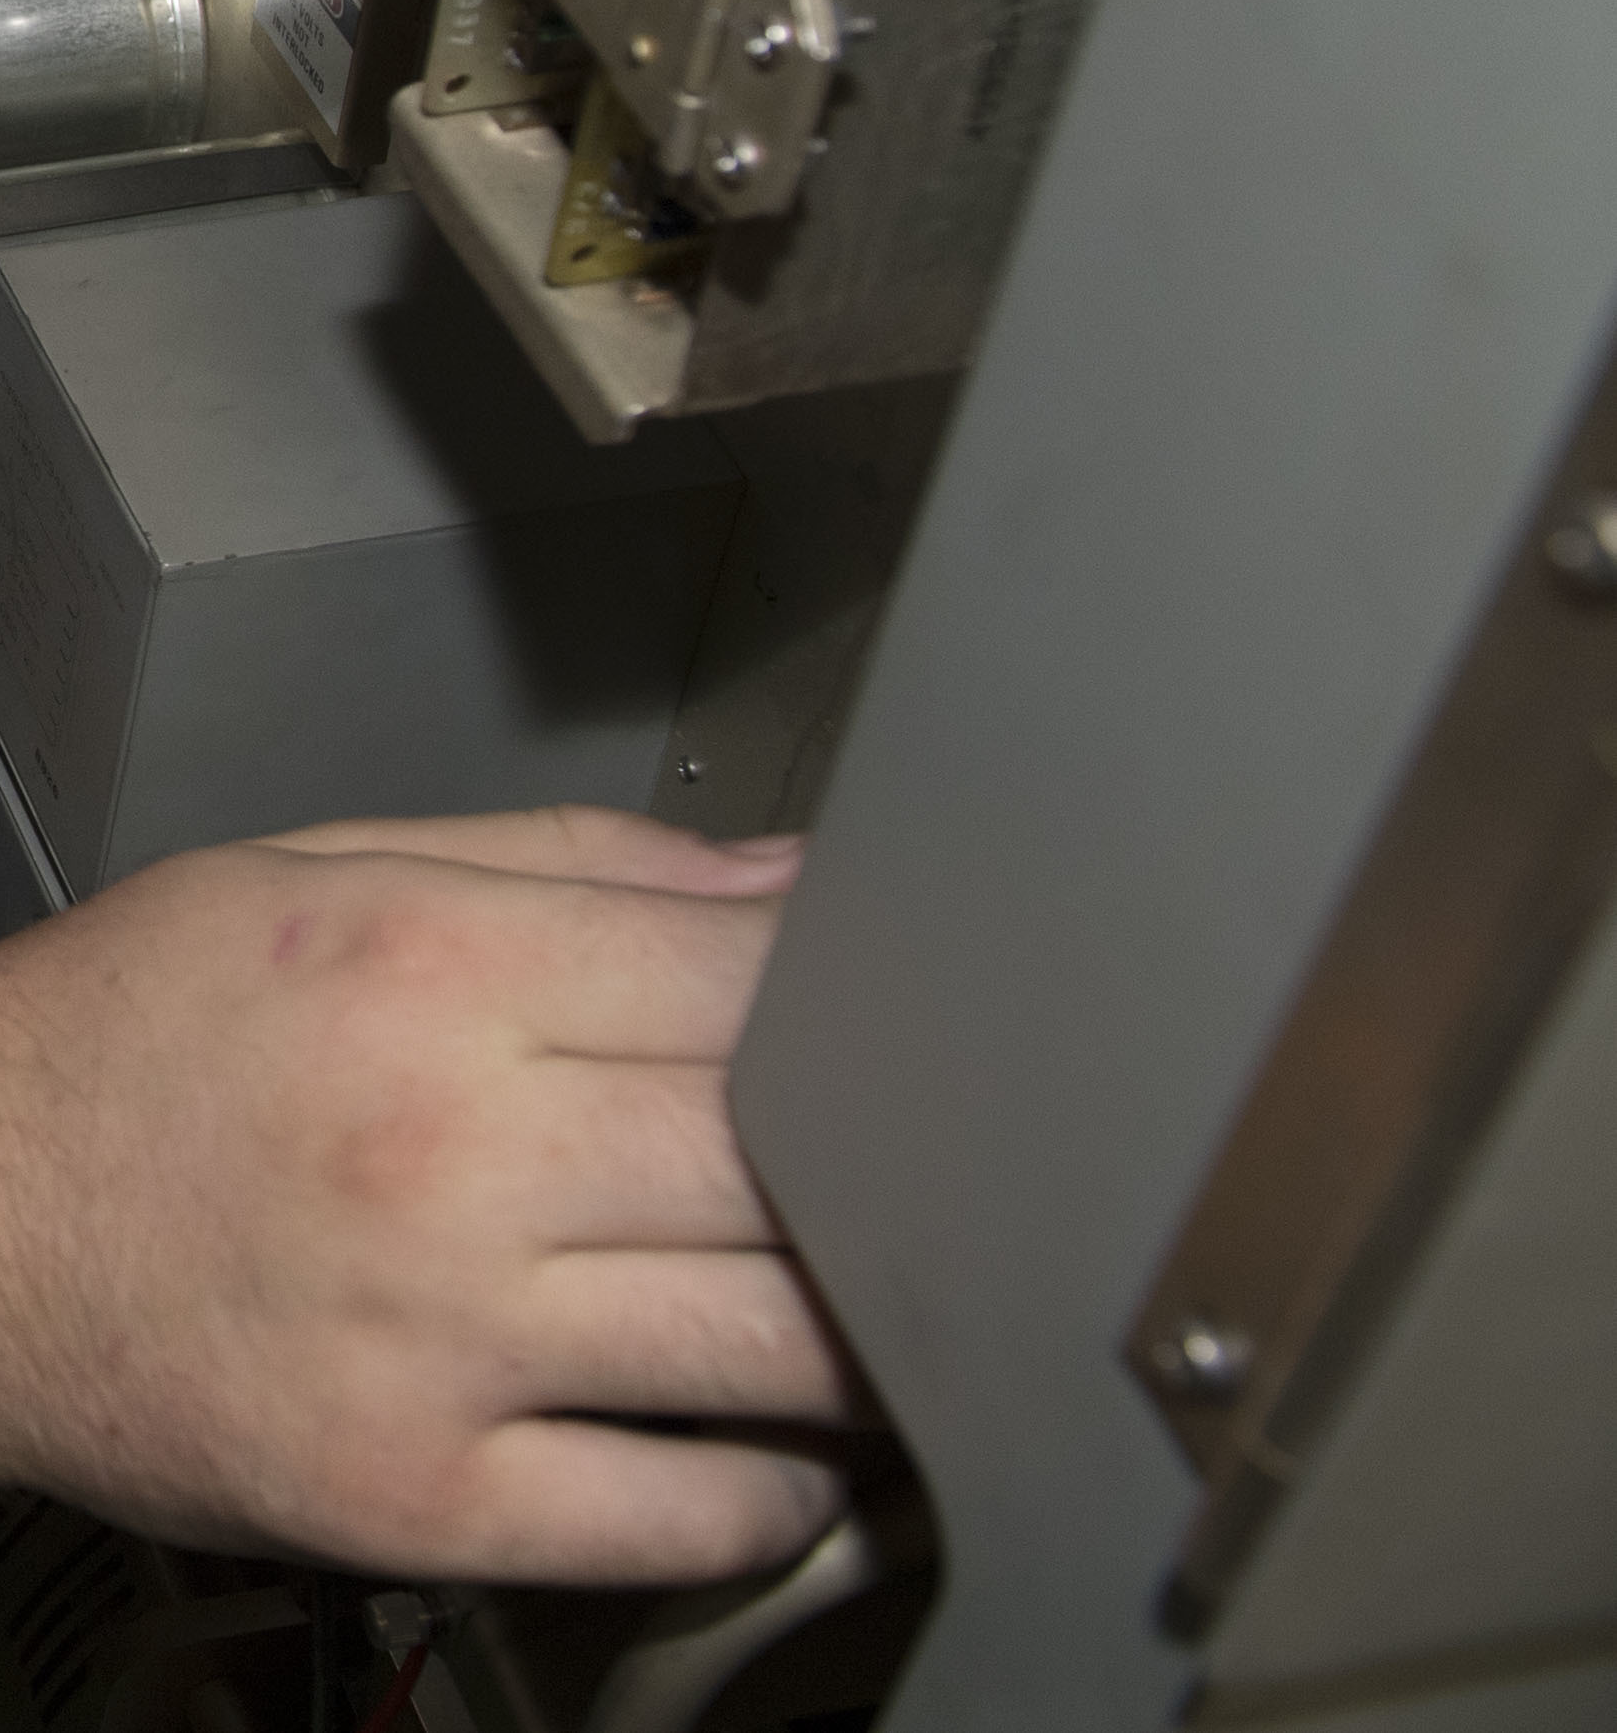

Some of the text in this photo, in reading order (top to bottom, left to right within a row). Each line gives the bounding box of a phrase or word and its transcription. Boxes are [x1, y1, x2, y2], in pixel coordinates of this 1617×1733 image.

[293, 18, 310, 49] NOT
[298, 3, 325, 48] VOLTS
[272, 12, 325, 95] INTERLOCKED
